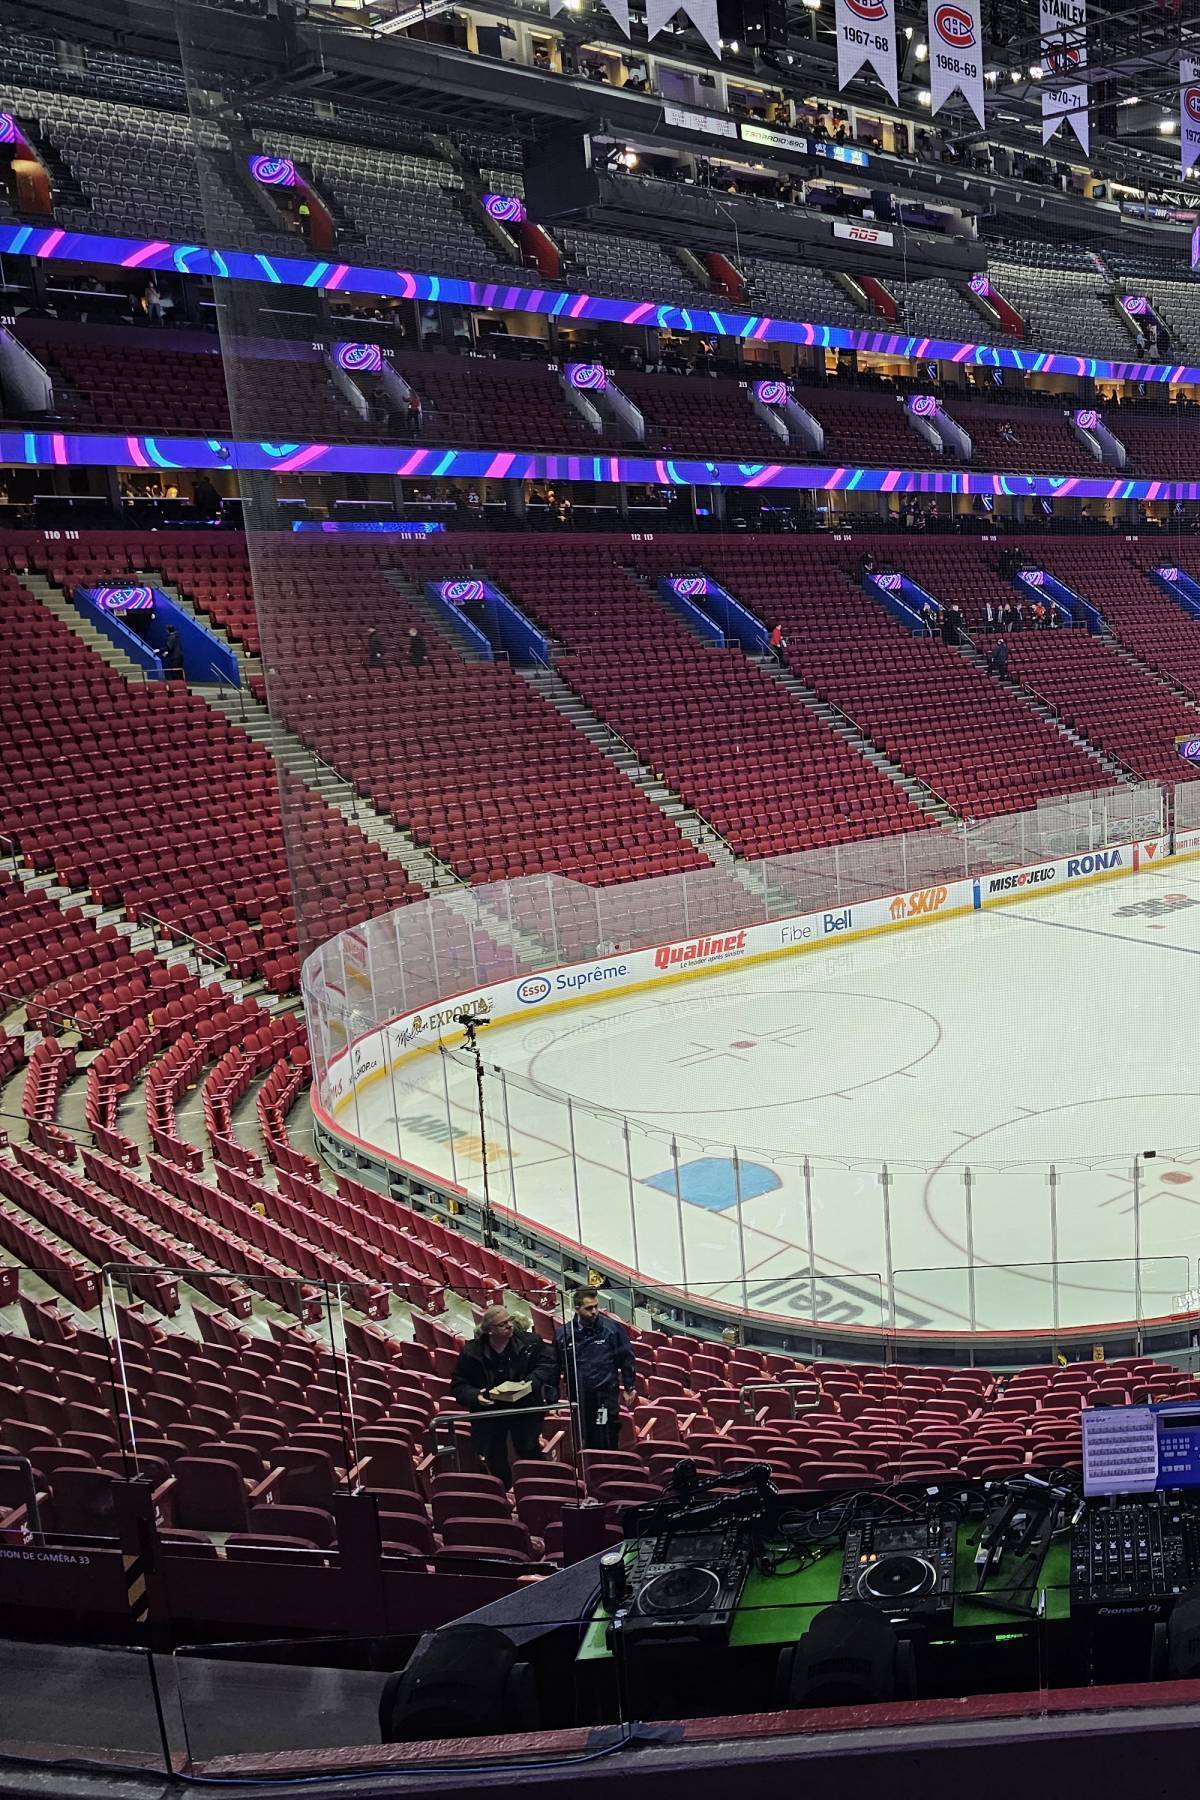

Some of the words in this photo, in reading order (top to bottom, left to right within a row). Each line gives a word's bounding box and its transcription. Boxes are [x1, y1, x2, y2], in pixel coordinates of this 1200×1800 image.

[843, 25, 889, 52] 1967-68
[935, 54, 977, 78] 1968-69
[849, 228, 878, 242] RDS
[0, 316, 16, 325] 211
[312, 343, 324, 351] 211
[382, 349, 395, 357] 212
[44, 530, 61, 540] 110
[64, 530, 79, 540] 111
[401, 532, 412, 540] 111
[415, 532, 427, 540] 112
[631, 533, 641, 541] 112
[644, 533, 654, 541] 113
[1067, 850, 1123, 877] RONA
[907, 886, 947, 916] SKIP
[824, 909, 852, 933] Bell
[781, 925, 811, 943] Fibe
[655, 930, 747, 970] Qualinet
[556, 965, 627, 990] Suprême
[23, 1552, 35, 1561] DE
[37, 1553, 77, 1564] CAMÉRA
[79, 1556, 90, 1565] 33
[1098, 1606, 1145, 1616] Pioneer
